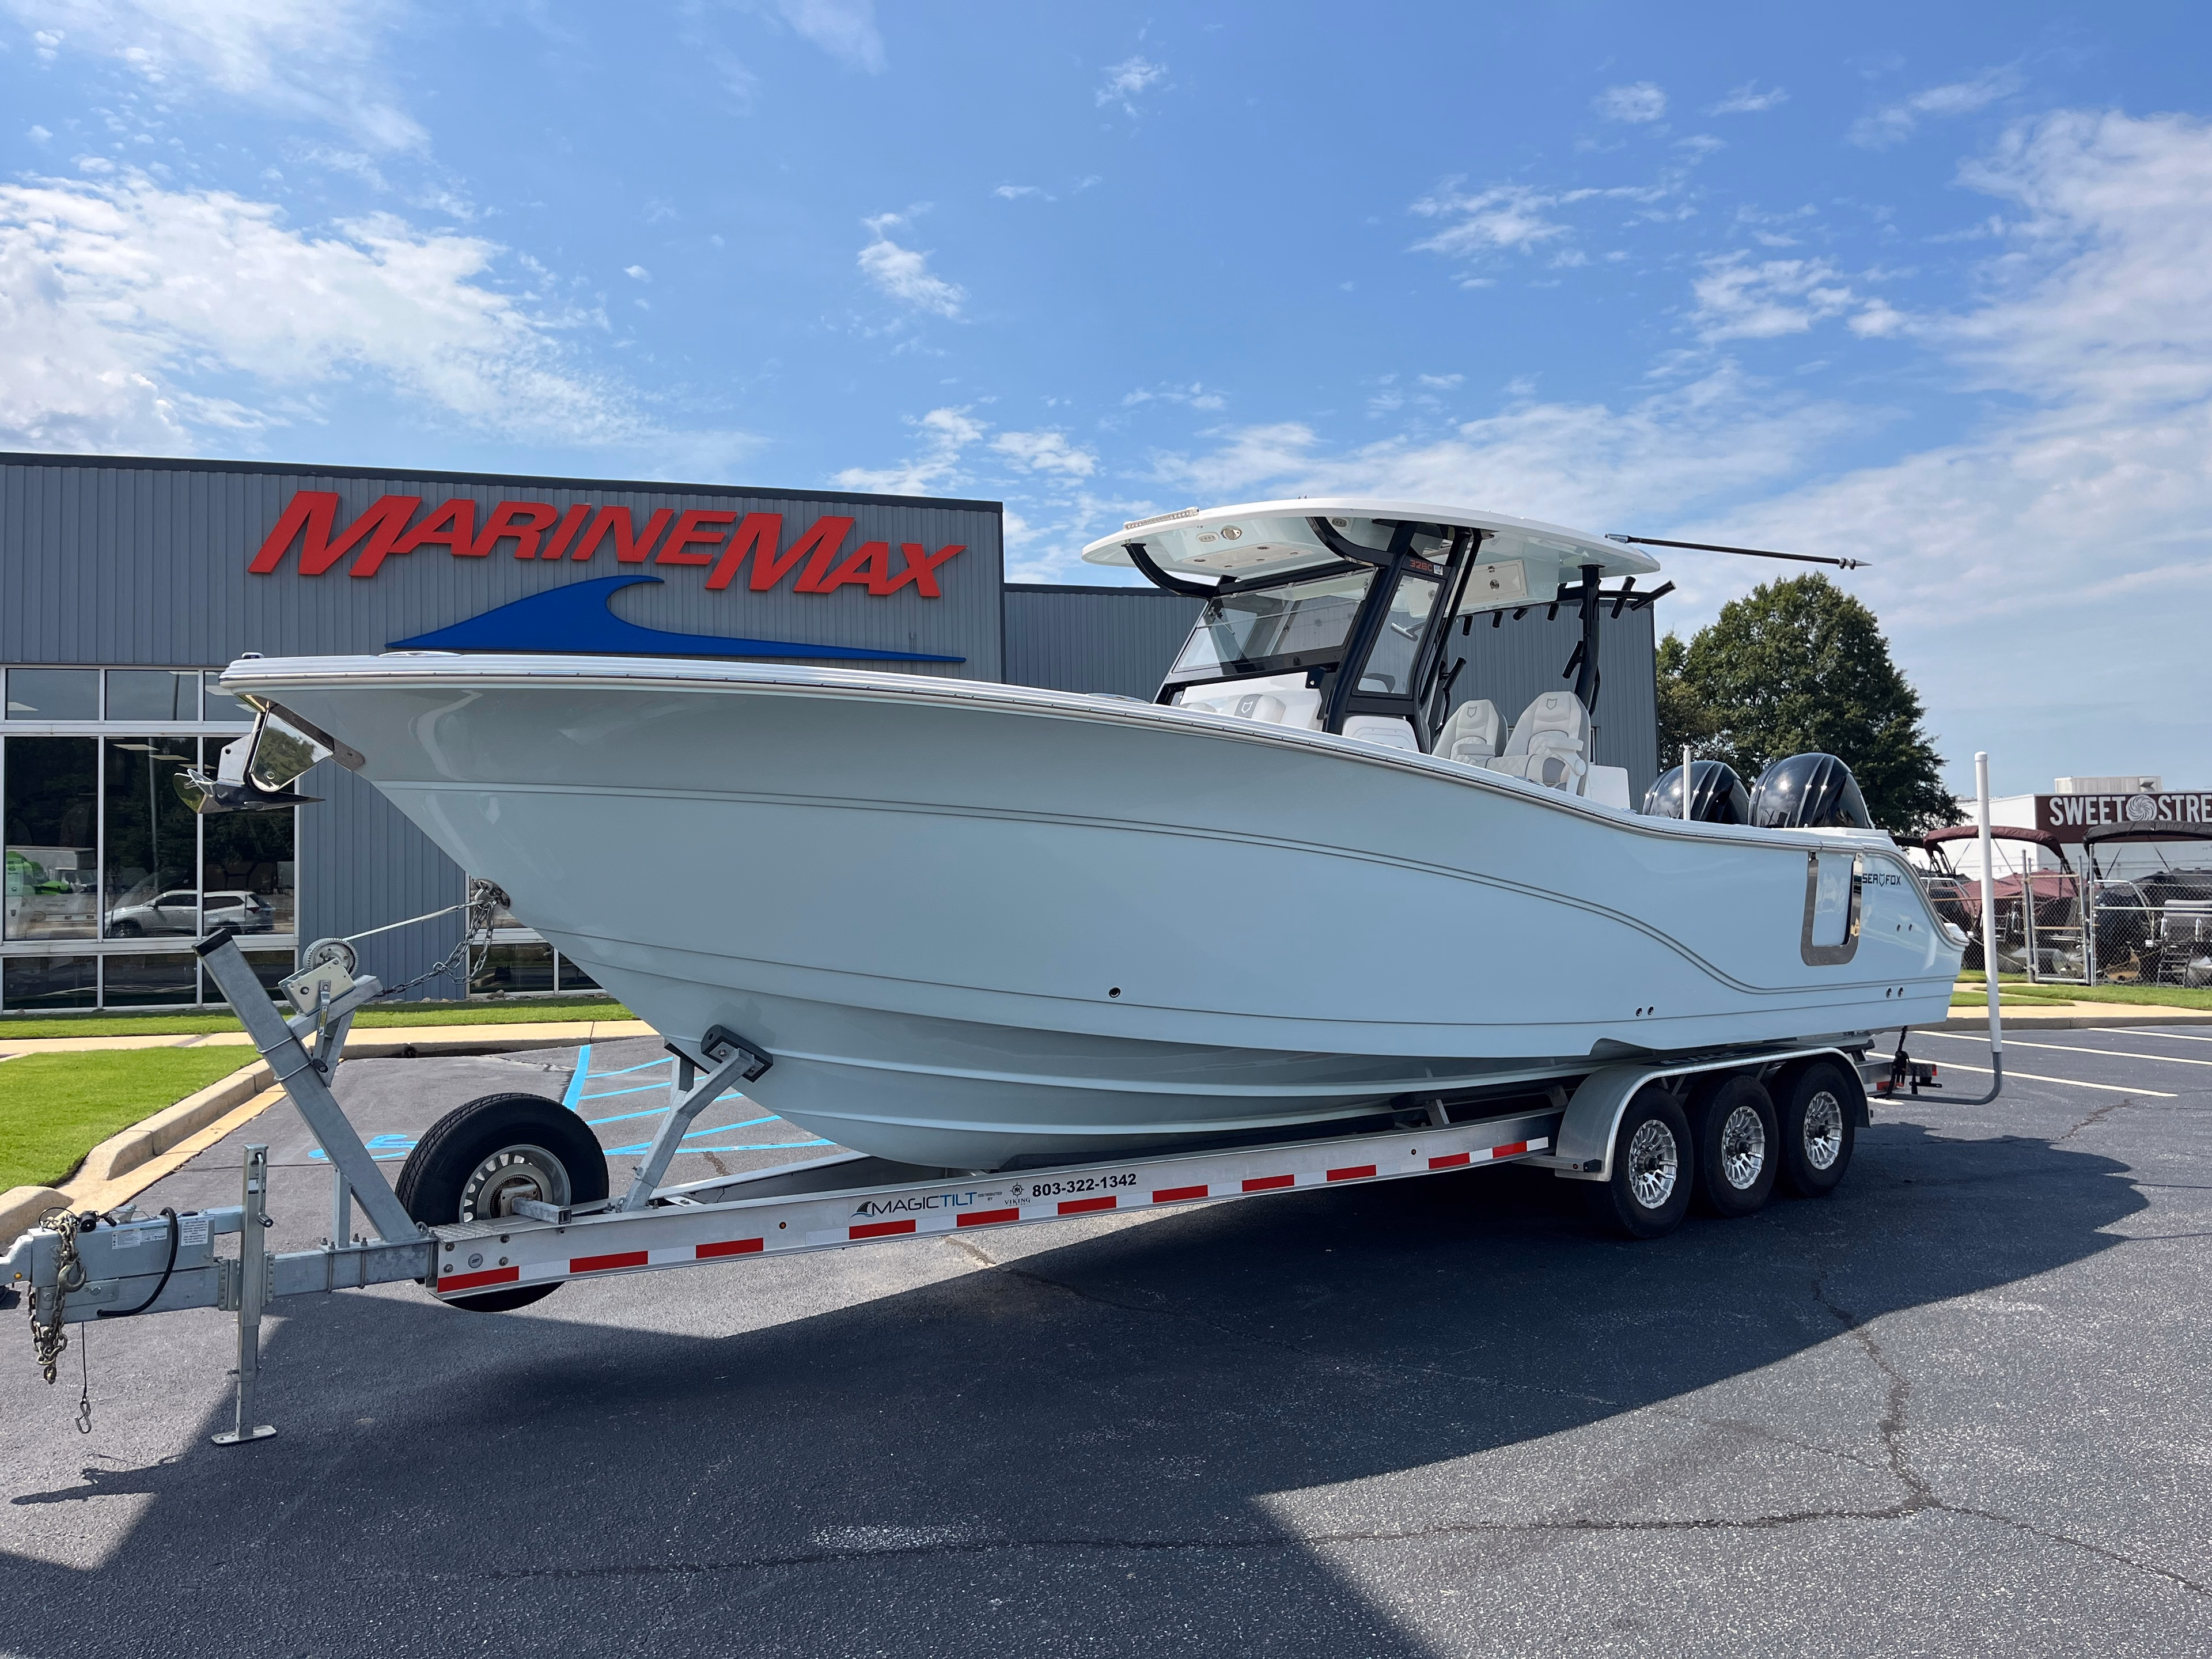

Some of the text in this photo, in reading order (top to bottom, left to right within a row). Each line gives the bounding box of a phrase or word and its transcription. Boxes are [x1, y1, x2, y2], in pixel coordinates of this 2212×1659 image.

[2049, 794, 2212, 825] SWEET STRE
[1862, 873, 1901, 885] SEA FOX
[1032, 1173, 1137, 1197] 803-322-1342
[872, 1192, 977, 1215] MAGICTILT
